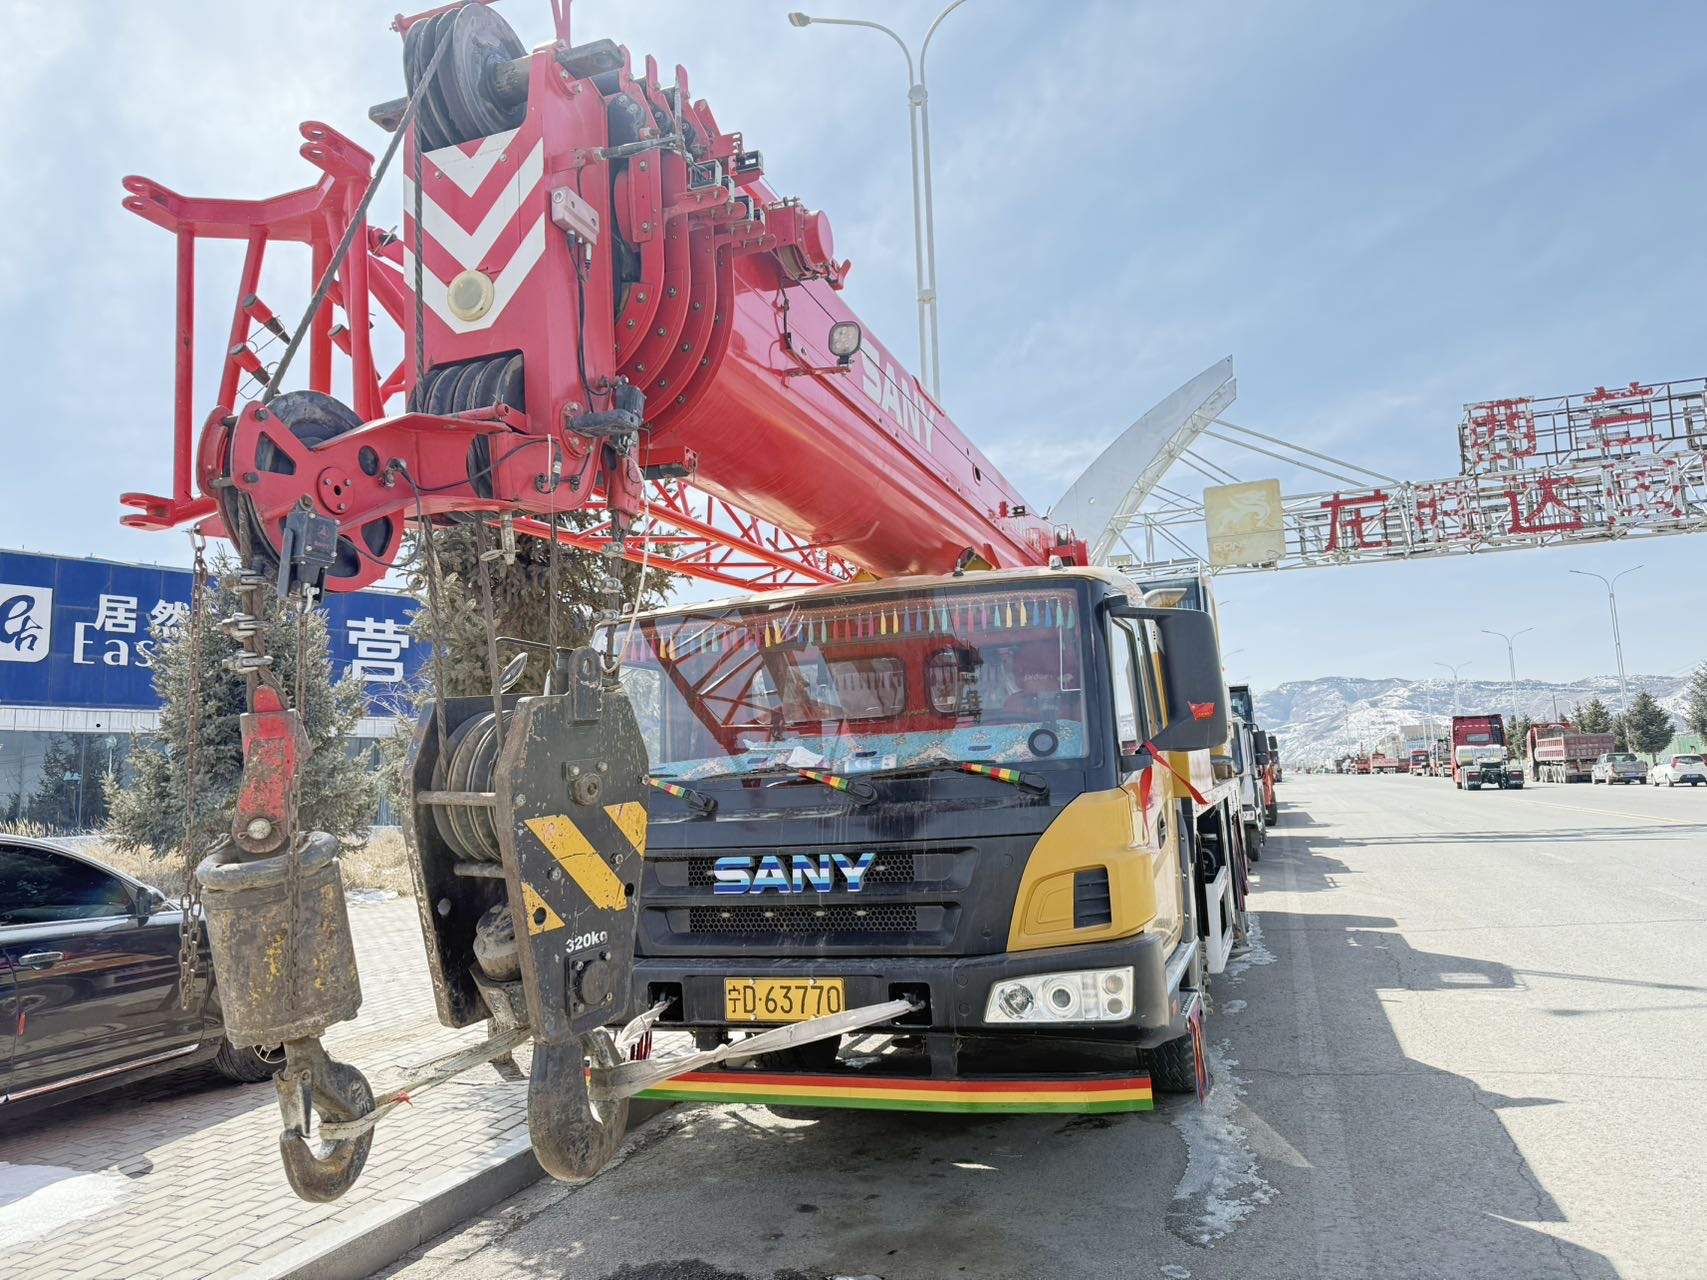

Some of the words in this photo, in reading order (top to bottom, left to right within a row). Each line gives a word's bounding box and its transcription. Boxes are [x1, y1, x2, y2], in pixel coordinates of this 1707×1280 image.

[860, 336, 937, 455] SANY
[346, 616, 410, 682] 营
[713, 852, 877, 895] SANY
[565, 931, 609, 954] 320kg
